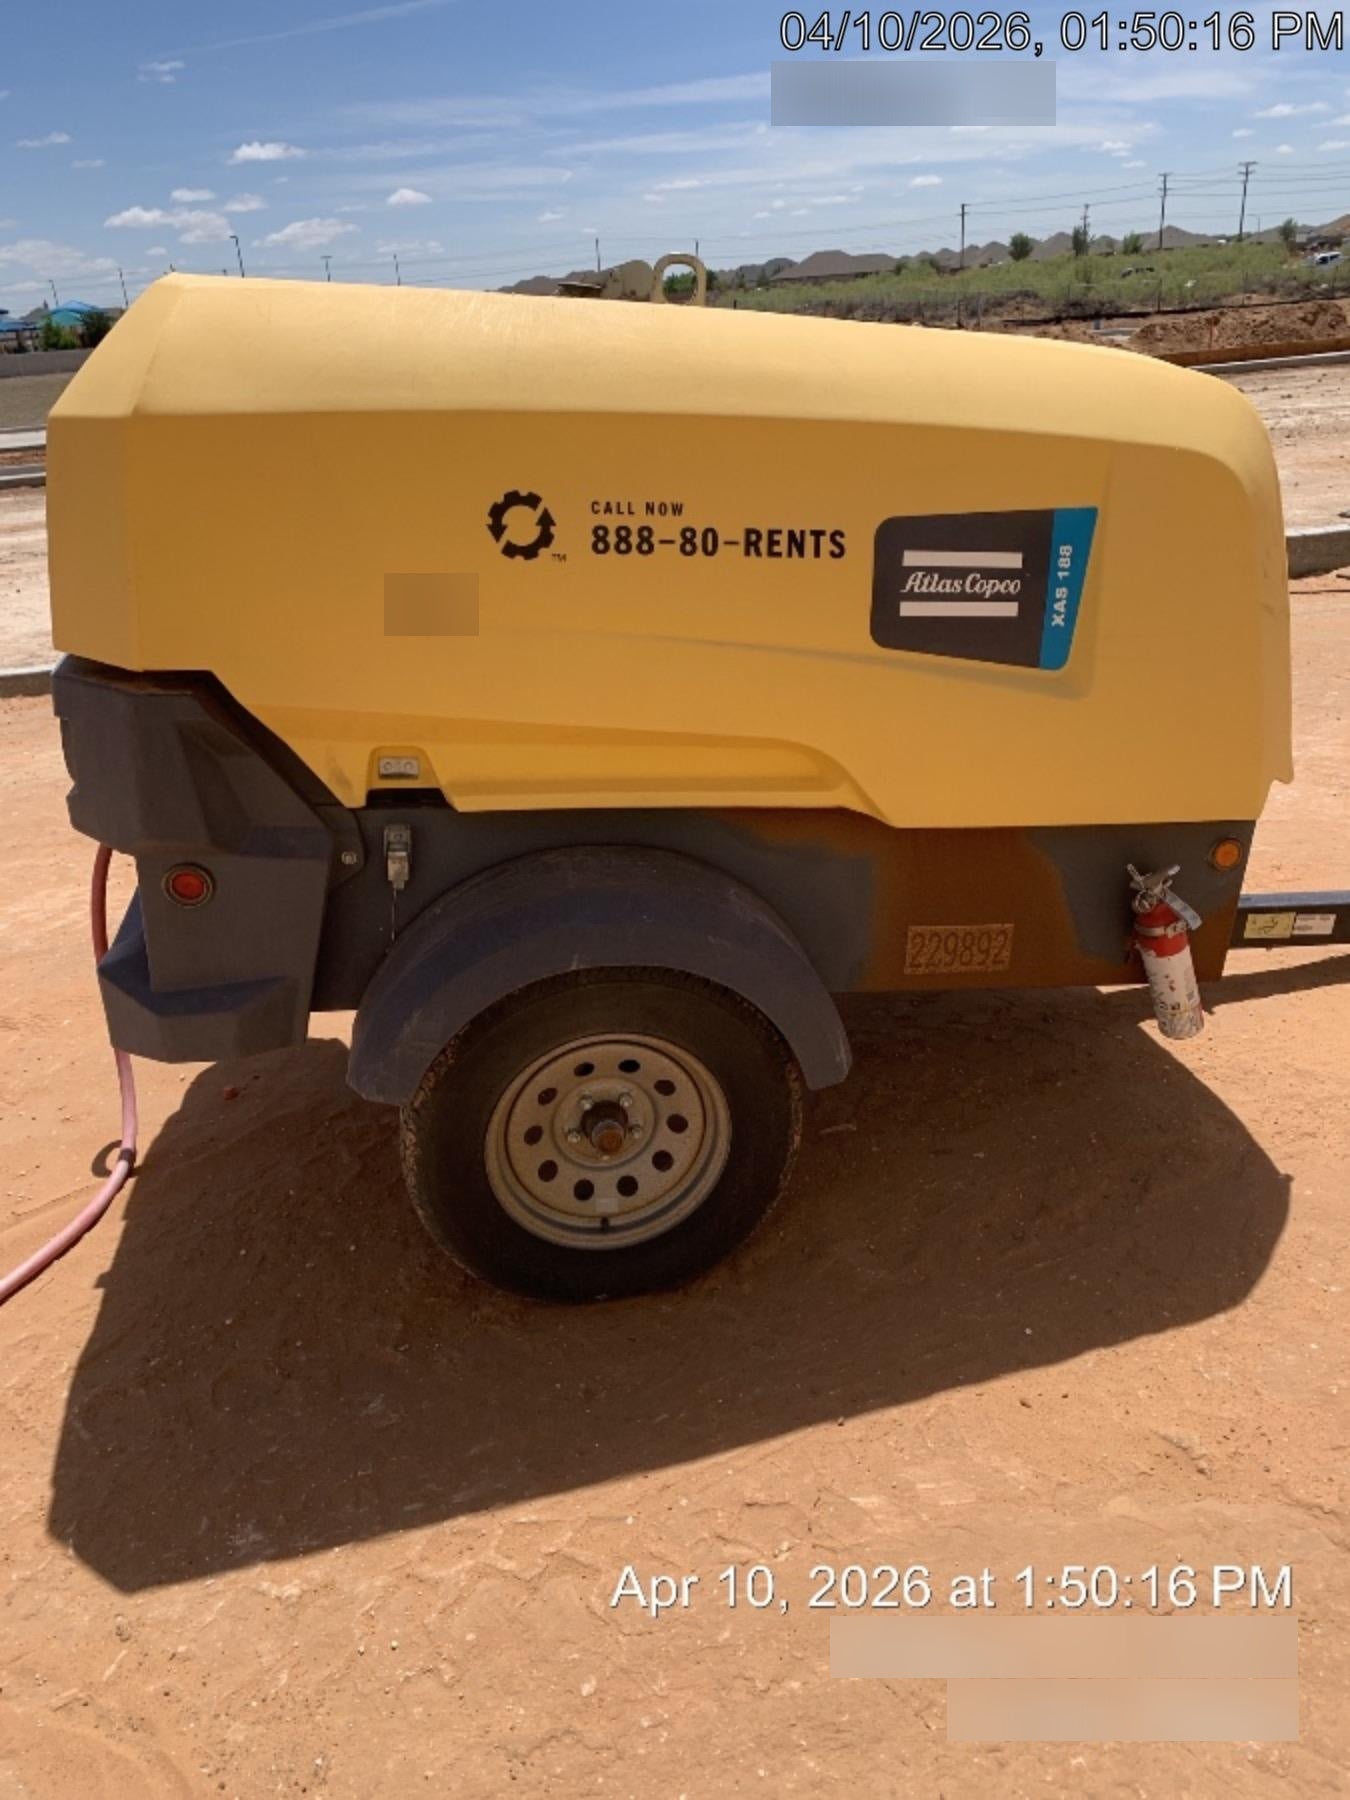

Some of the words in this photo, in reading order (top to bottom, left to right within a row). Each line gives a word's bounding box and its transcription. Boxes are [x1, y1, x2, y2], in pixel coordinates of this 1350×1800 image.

[591, 500, 636, 516] CALL
[645, 501, 684, 517] NOW
[591, 525, 846, 559] 888-80-RENTS
[1057, 545, 1073, 581] 188
[1051, 587, 1068, 627] XAS
[910, 929, 1009, 968] 229892
